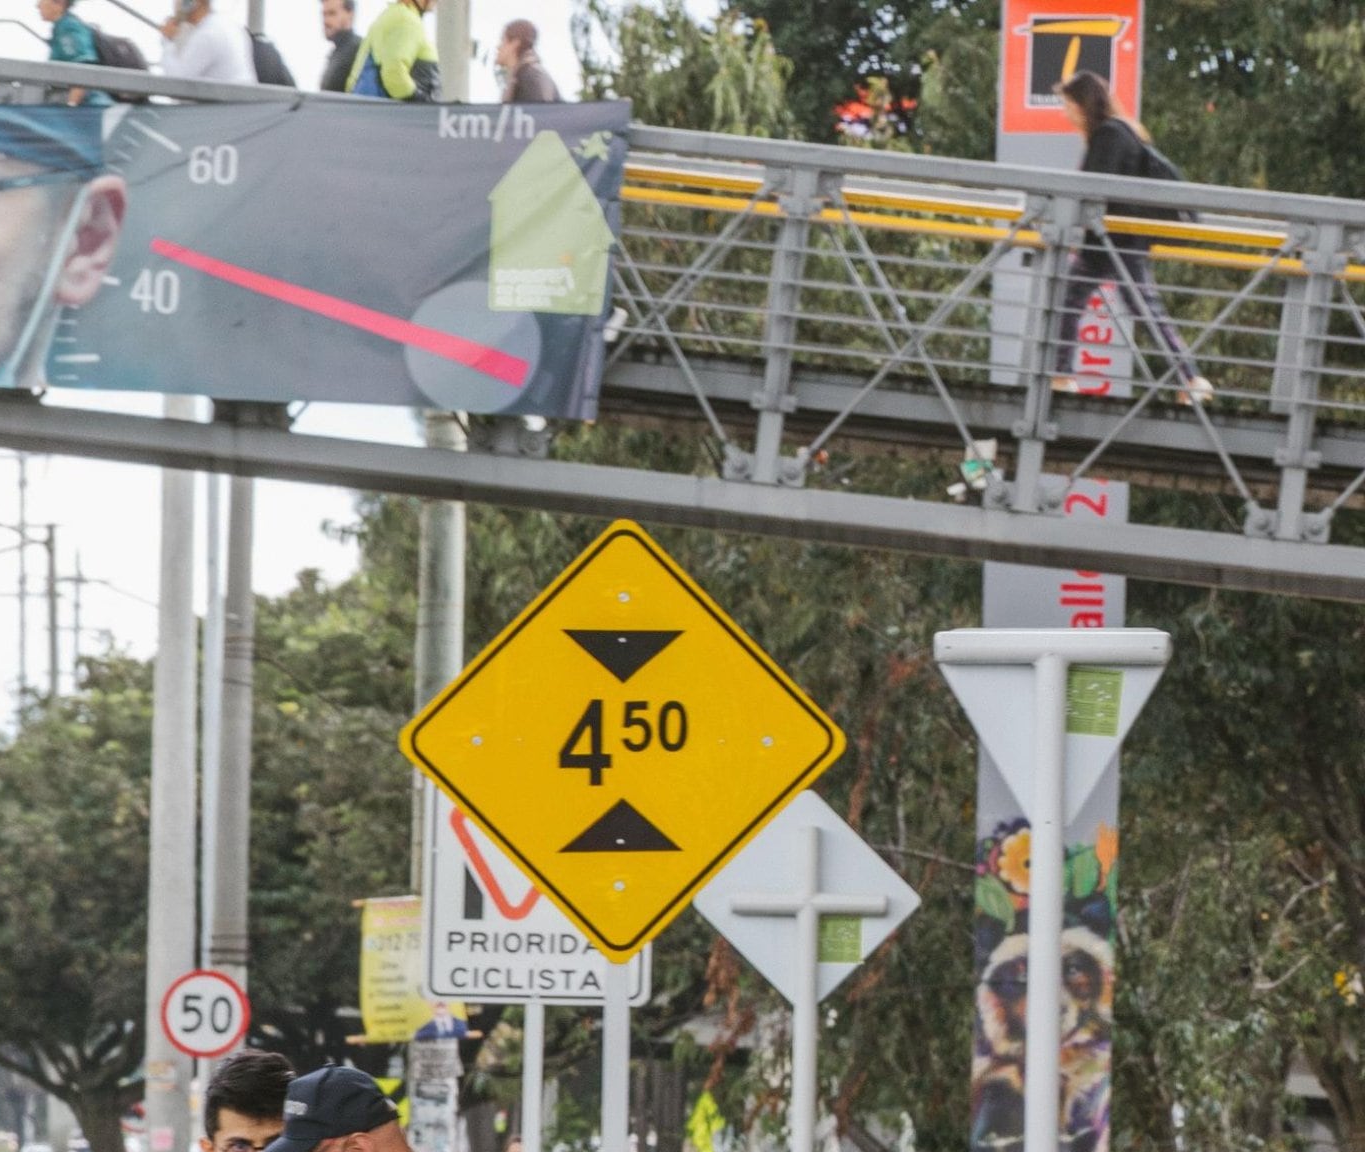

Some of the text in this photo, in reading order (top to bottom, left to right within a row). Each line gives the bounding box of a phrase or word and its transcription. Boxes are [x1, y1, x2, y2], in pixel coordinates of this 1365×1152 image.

[437, 105, 536, 142] km/h
[188, 144, 239, 185] 60
[130, 270, 180, 314] 40
[450, 967, 601, 990] CICLISTA
[181, 994, 232, 1033] 50
